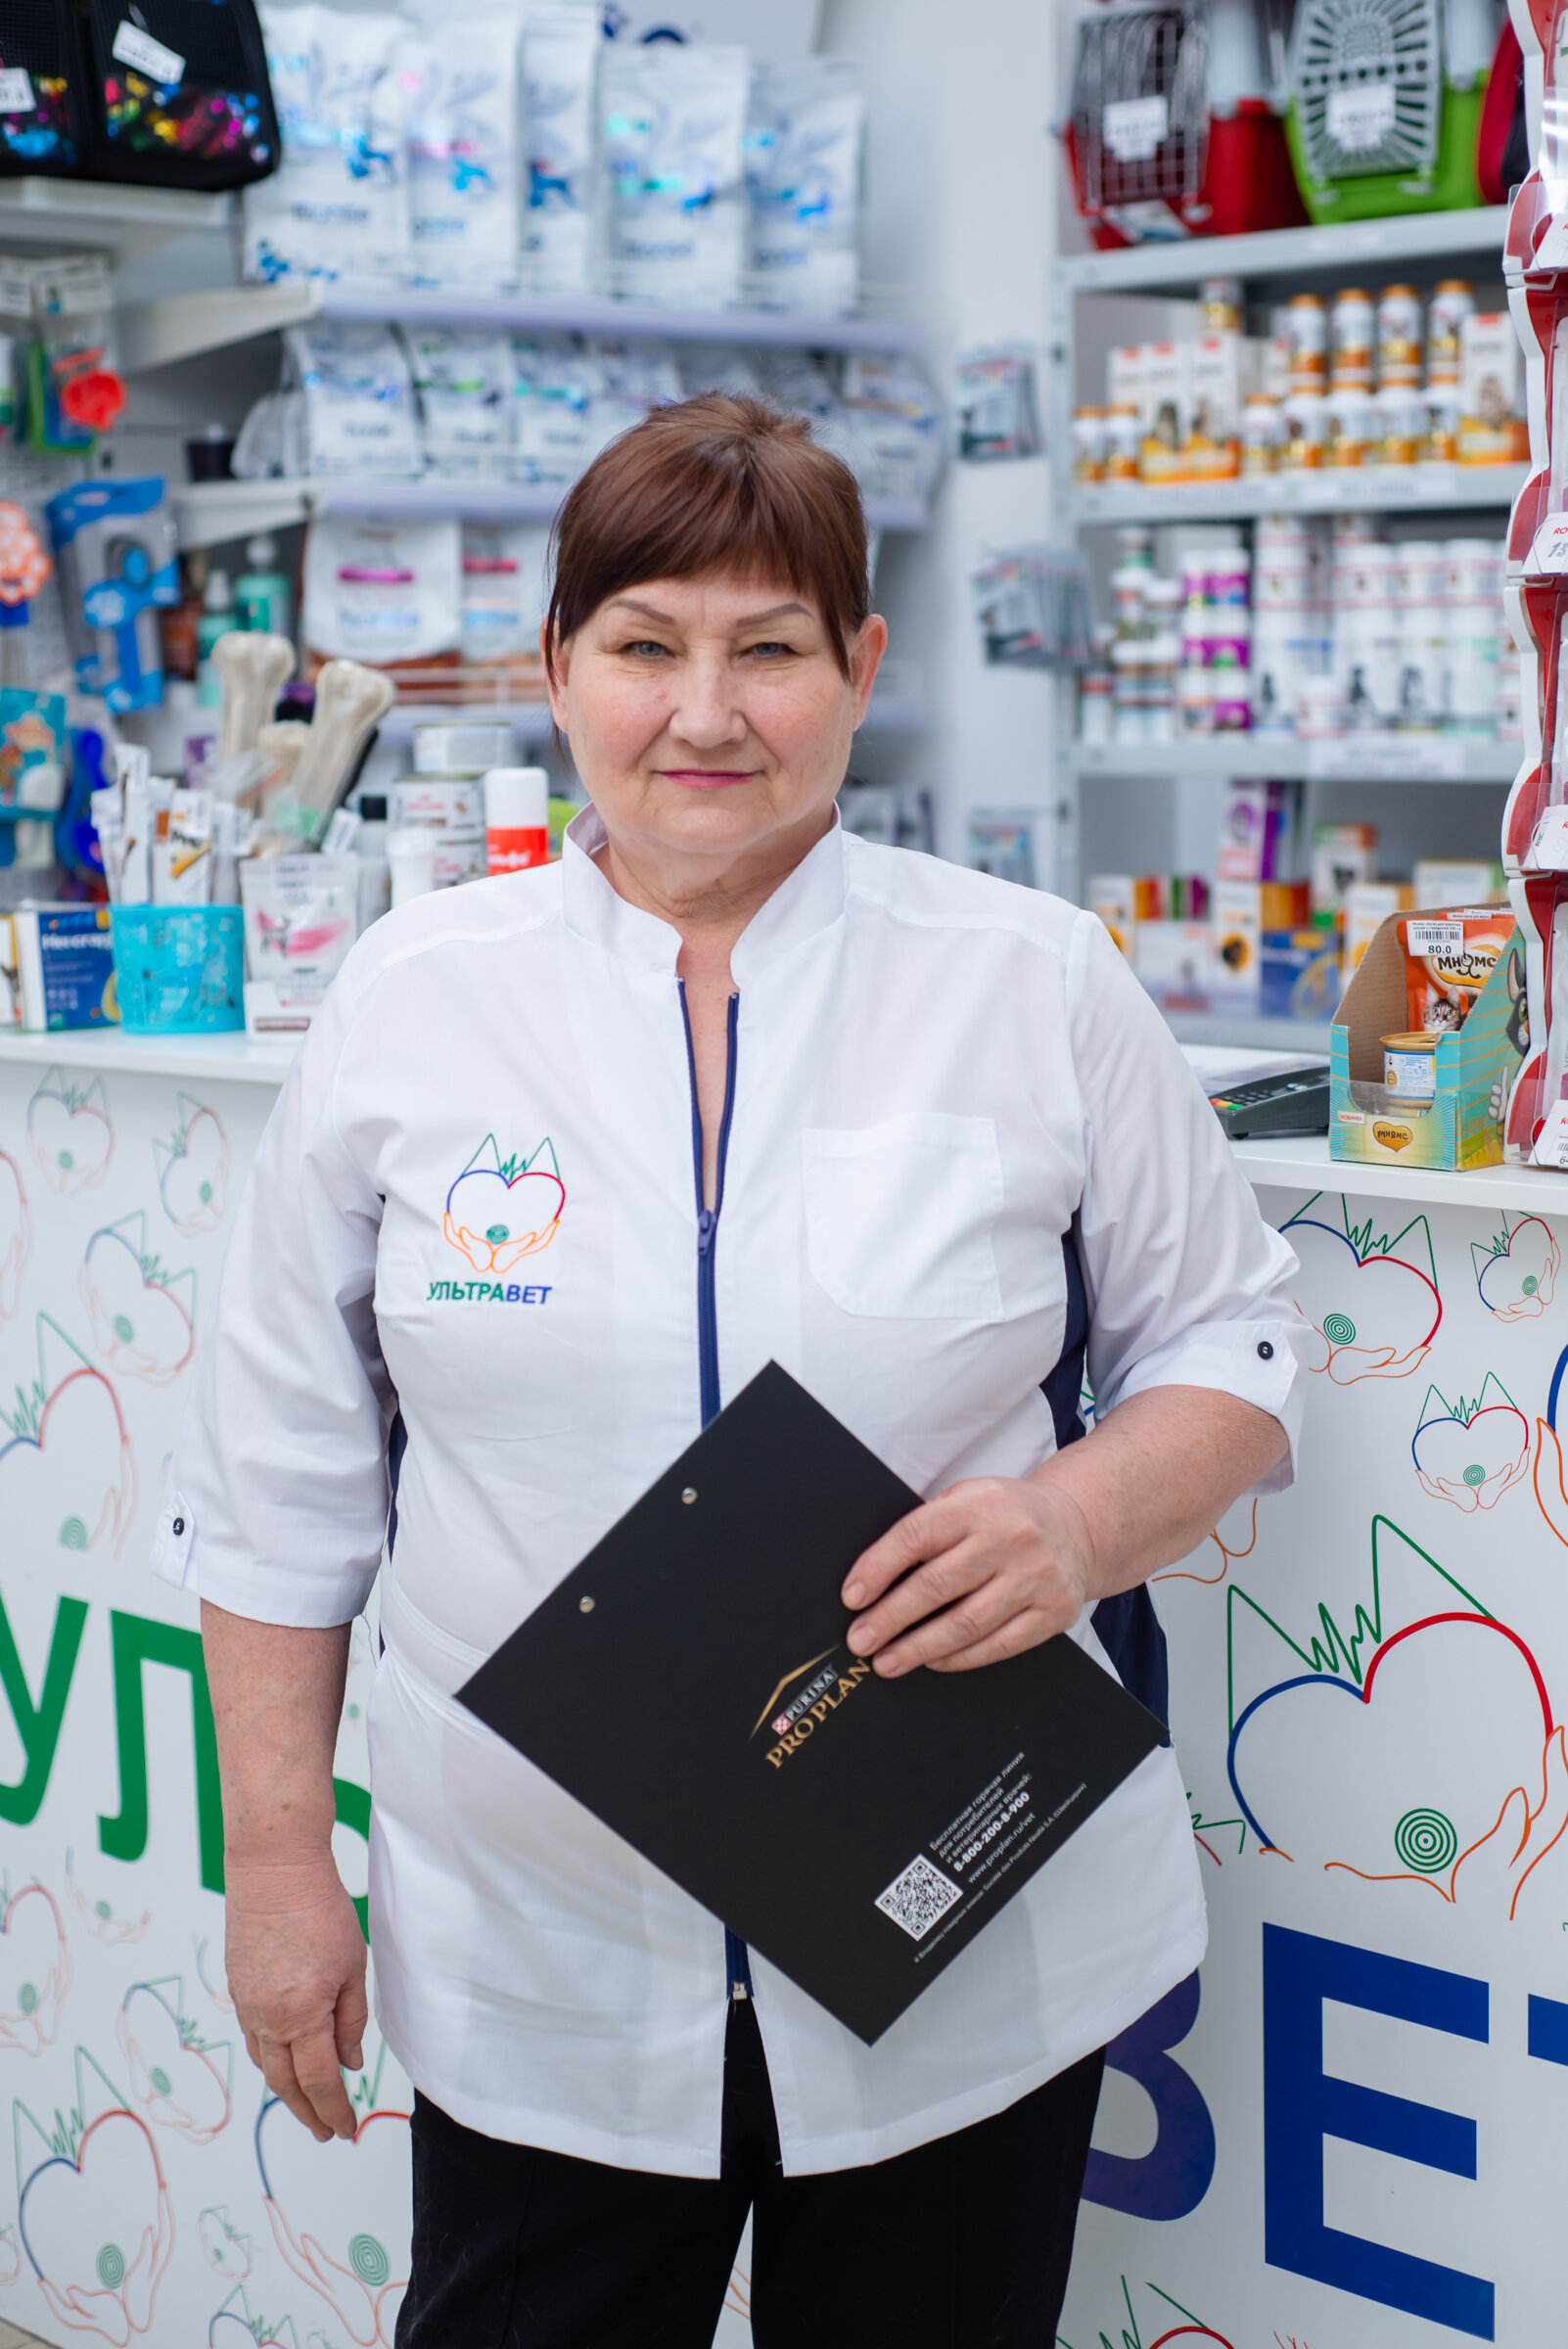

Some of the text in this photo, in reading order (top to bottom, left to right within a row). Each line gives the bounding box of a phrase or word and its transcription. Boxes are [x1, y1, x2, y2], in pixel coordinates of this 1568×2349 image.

[1428, 945, 1452, 954] 80.0
[426, 1281, 553, 1305] УЛЬТРАВЕТ
[765, 1658, 871, 1770] PRO PLAN
[785, 1670, 834, 1723] PURINA
[929, 1752, 1025, 1851] Бесплатная горячая линия
[939, 1787, 1004, 1859] для потребителей
[945, 1773, 1033, 1865] и ветеринарных врачей:
[952, 1791, 1030, 1872] 8-800-200-8-900
[967, 1812, 1036, 1884] www.proplan.ru/vet
